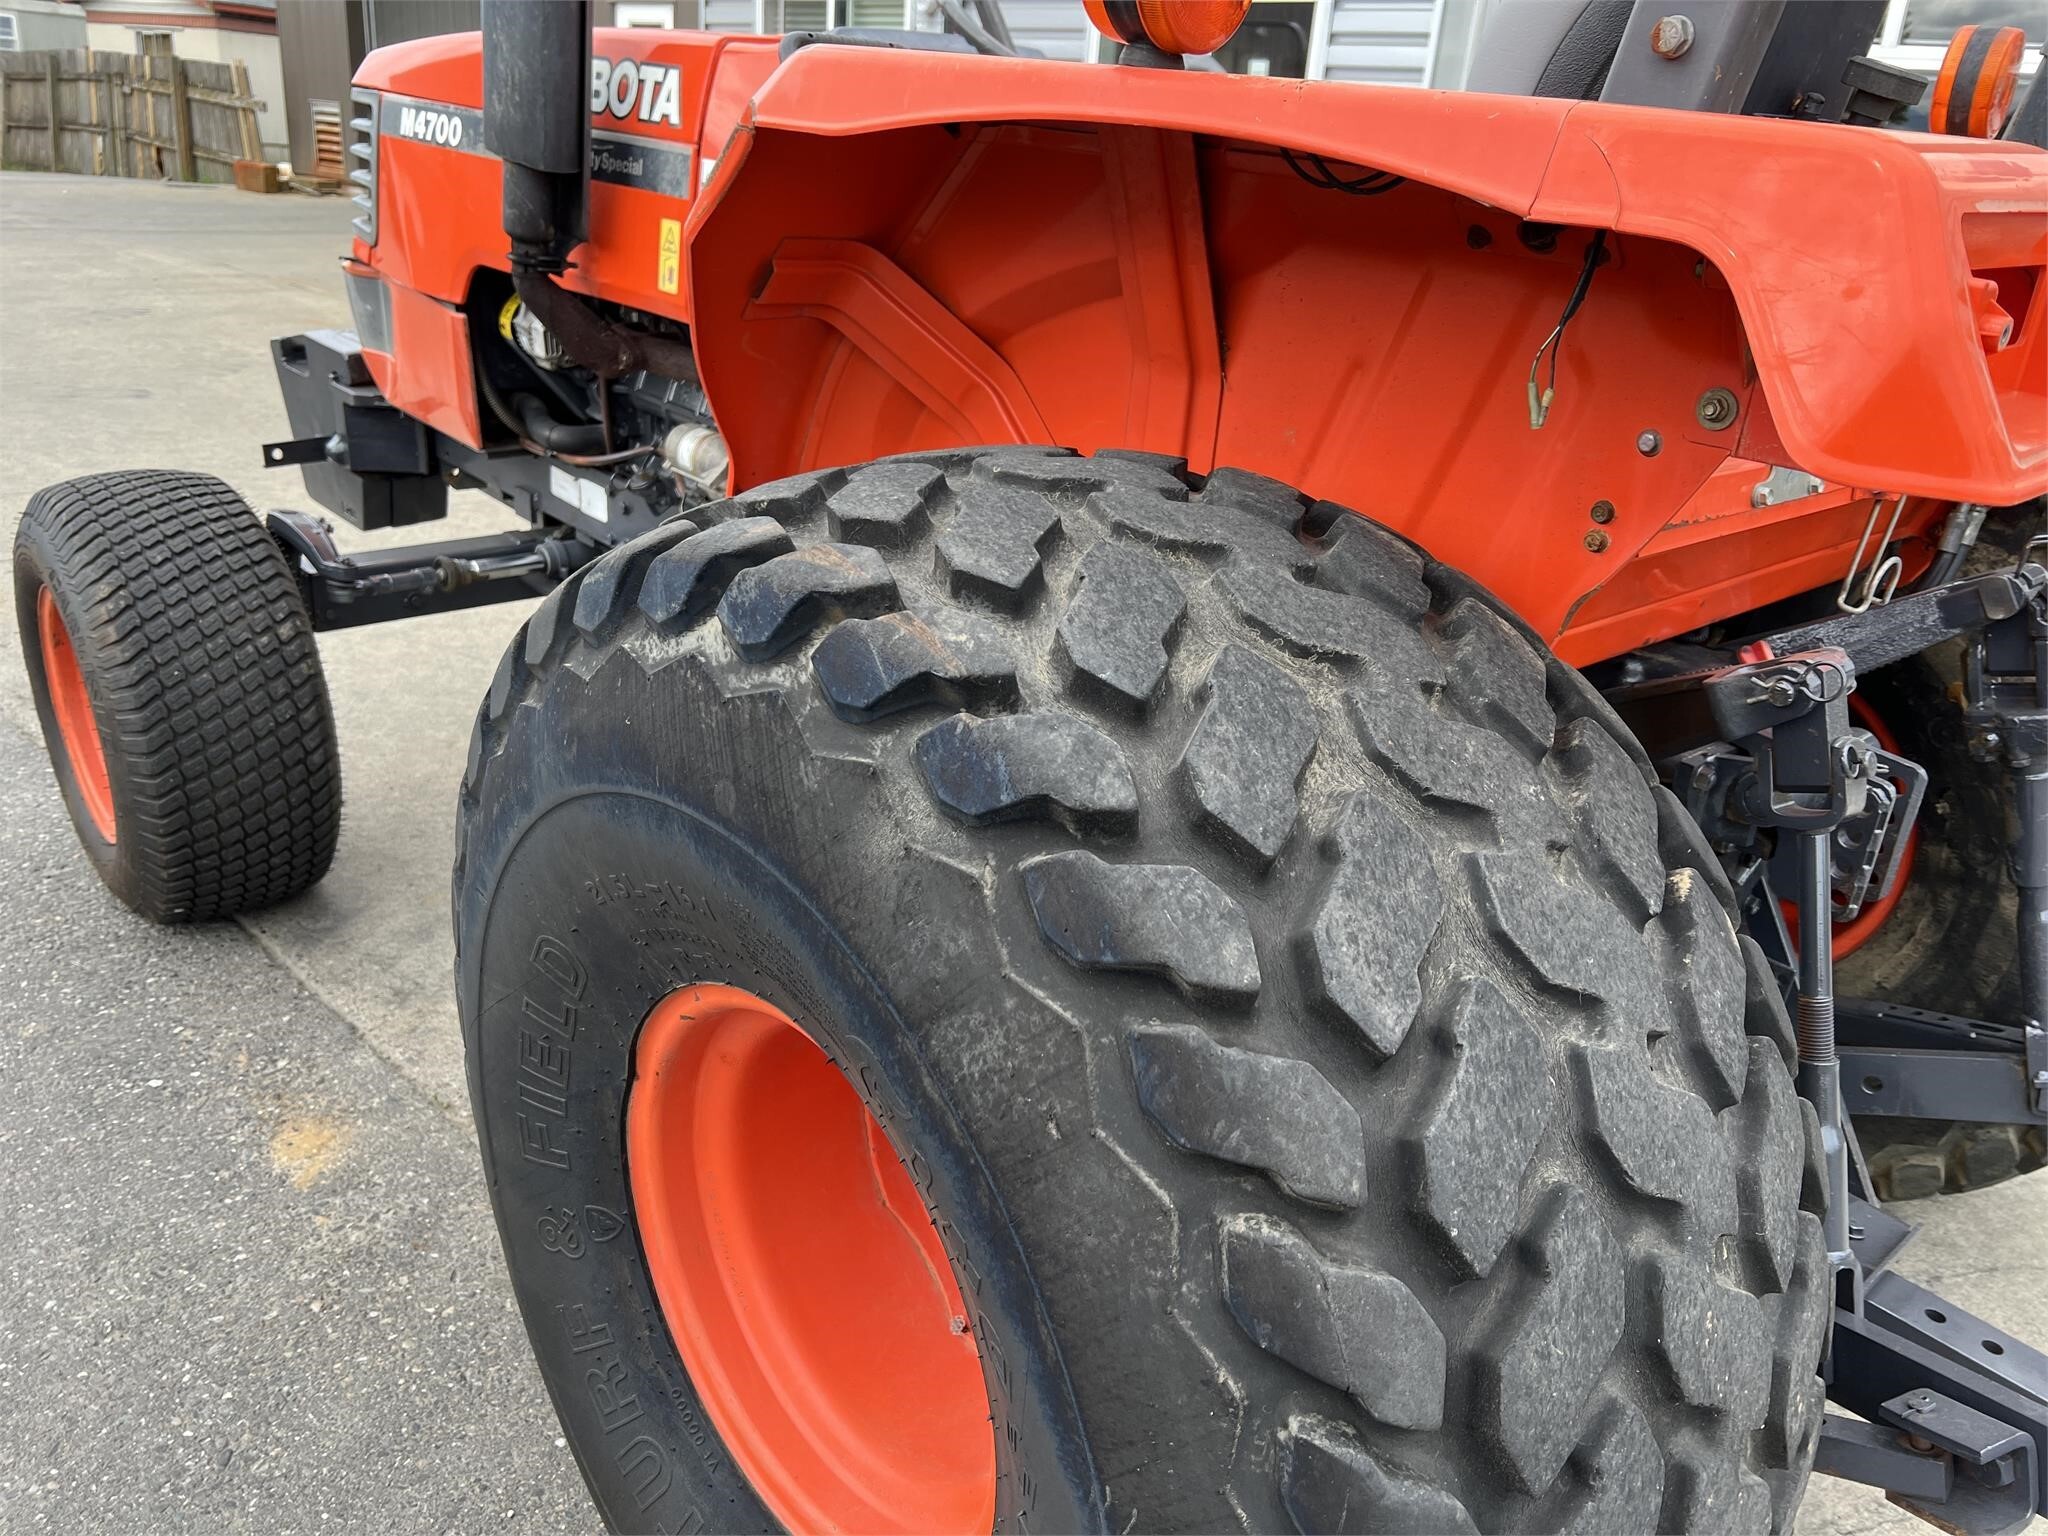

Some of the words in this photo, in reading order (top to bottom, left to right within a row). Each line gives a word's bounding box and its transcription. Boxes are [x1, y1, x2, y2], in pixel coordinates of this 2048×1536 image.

[591, 58, 682, 126] BOTA
[400, 107, 463, 147] M4700
[601, 151, 643, 177] Special
[515, 935, 589, 1171] FIELD
[537, 1207, 587, 1259] &
